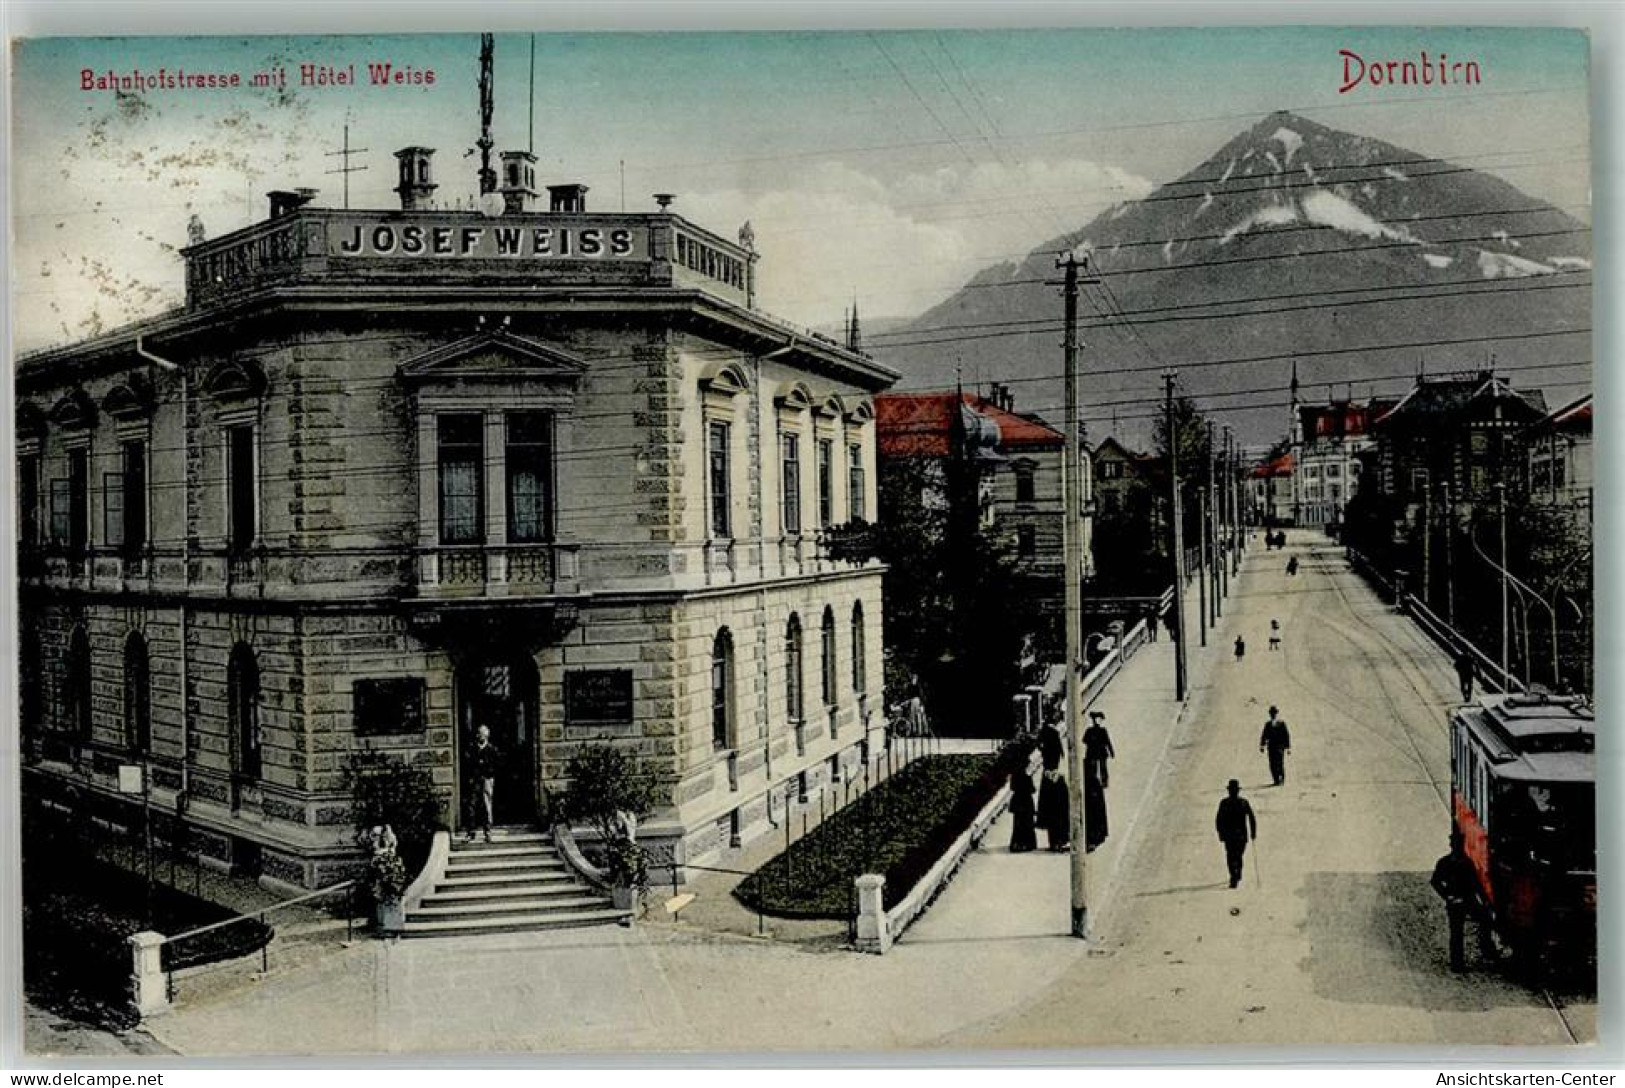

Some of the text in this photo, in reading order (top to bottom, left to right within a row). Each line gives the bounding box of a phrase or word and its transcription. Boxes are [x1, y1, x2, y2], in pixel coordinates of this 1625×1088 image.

[80, 63, 435, 93] Bahnhofstrasse mit Hôtel Weiss
[1339, 50, 1481, 93] Dornbirn
[341, 225, 635, 257] JOSEF WEISS
